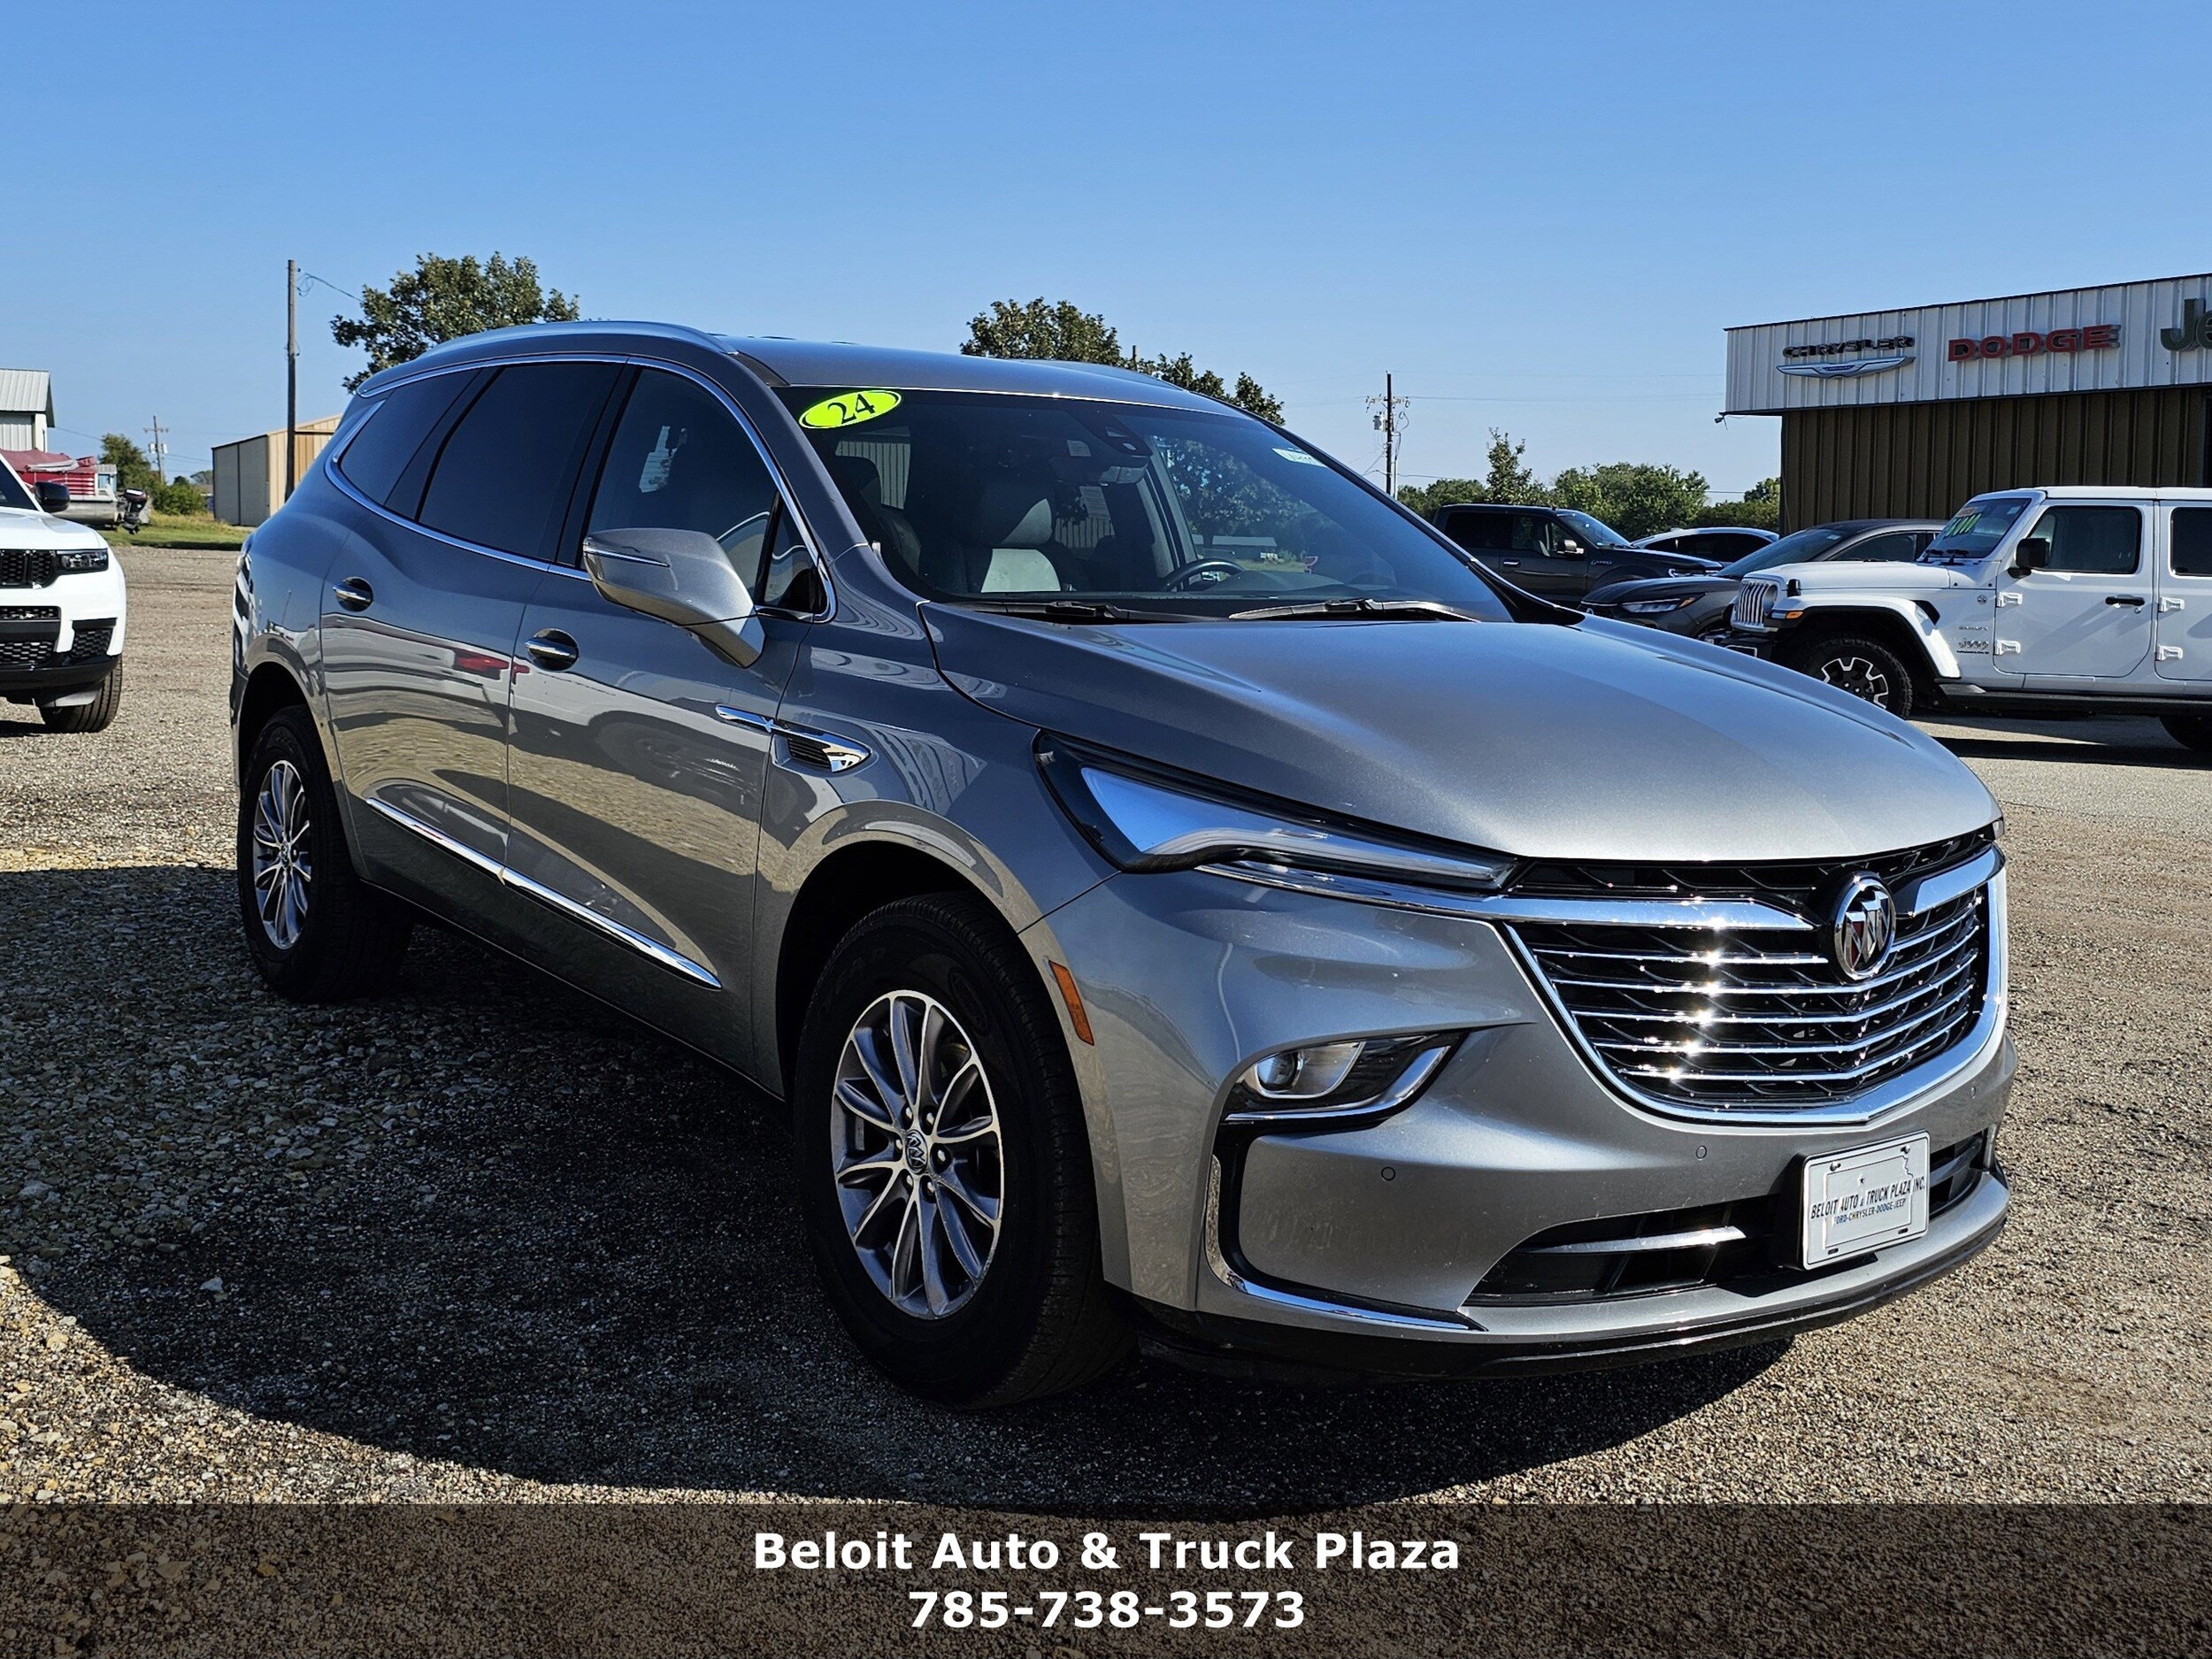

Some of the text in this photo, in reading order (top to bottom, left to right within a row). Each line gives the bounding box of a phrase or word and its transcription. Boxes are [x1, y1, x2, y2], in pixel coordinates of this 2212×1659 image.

[1783, 335, 1916, 357] CHRYSLER
[1948, 324, 2122, 362] DODGE
[827, 393, 876, 425] 24
[1810, 1199, 1839, 1219] BELOIT
[1840, 1194, 1859, 1212] AUTO
[1866, 1186, 1890, 1205] TRUCK
[1890, 1179, 1911, 1199] PLAZA
